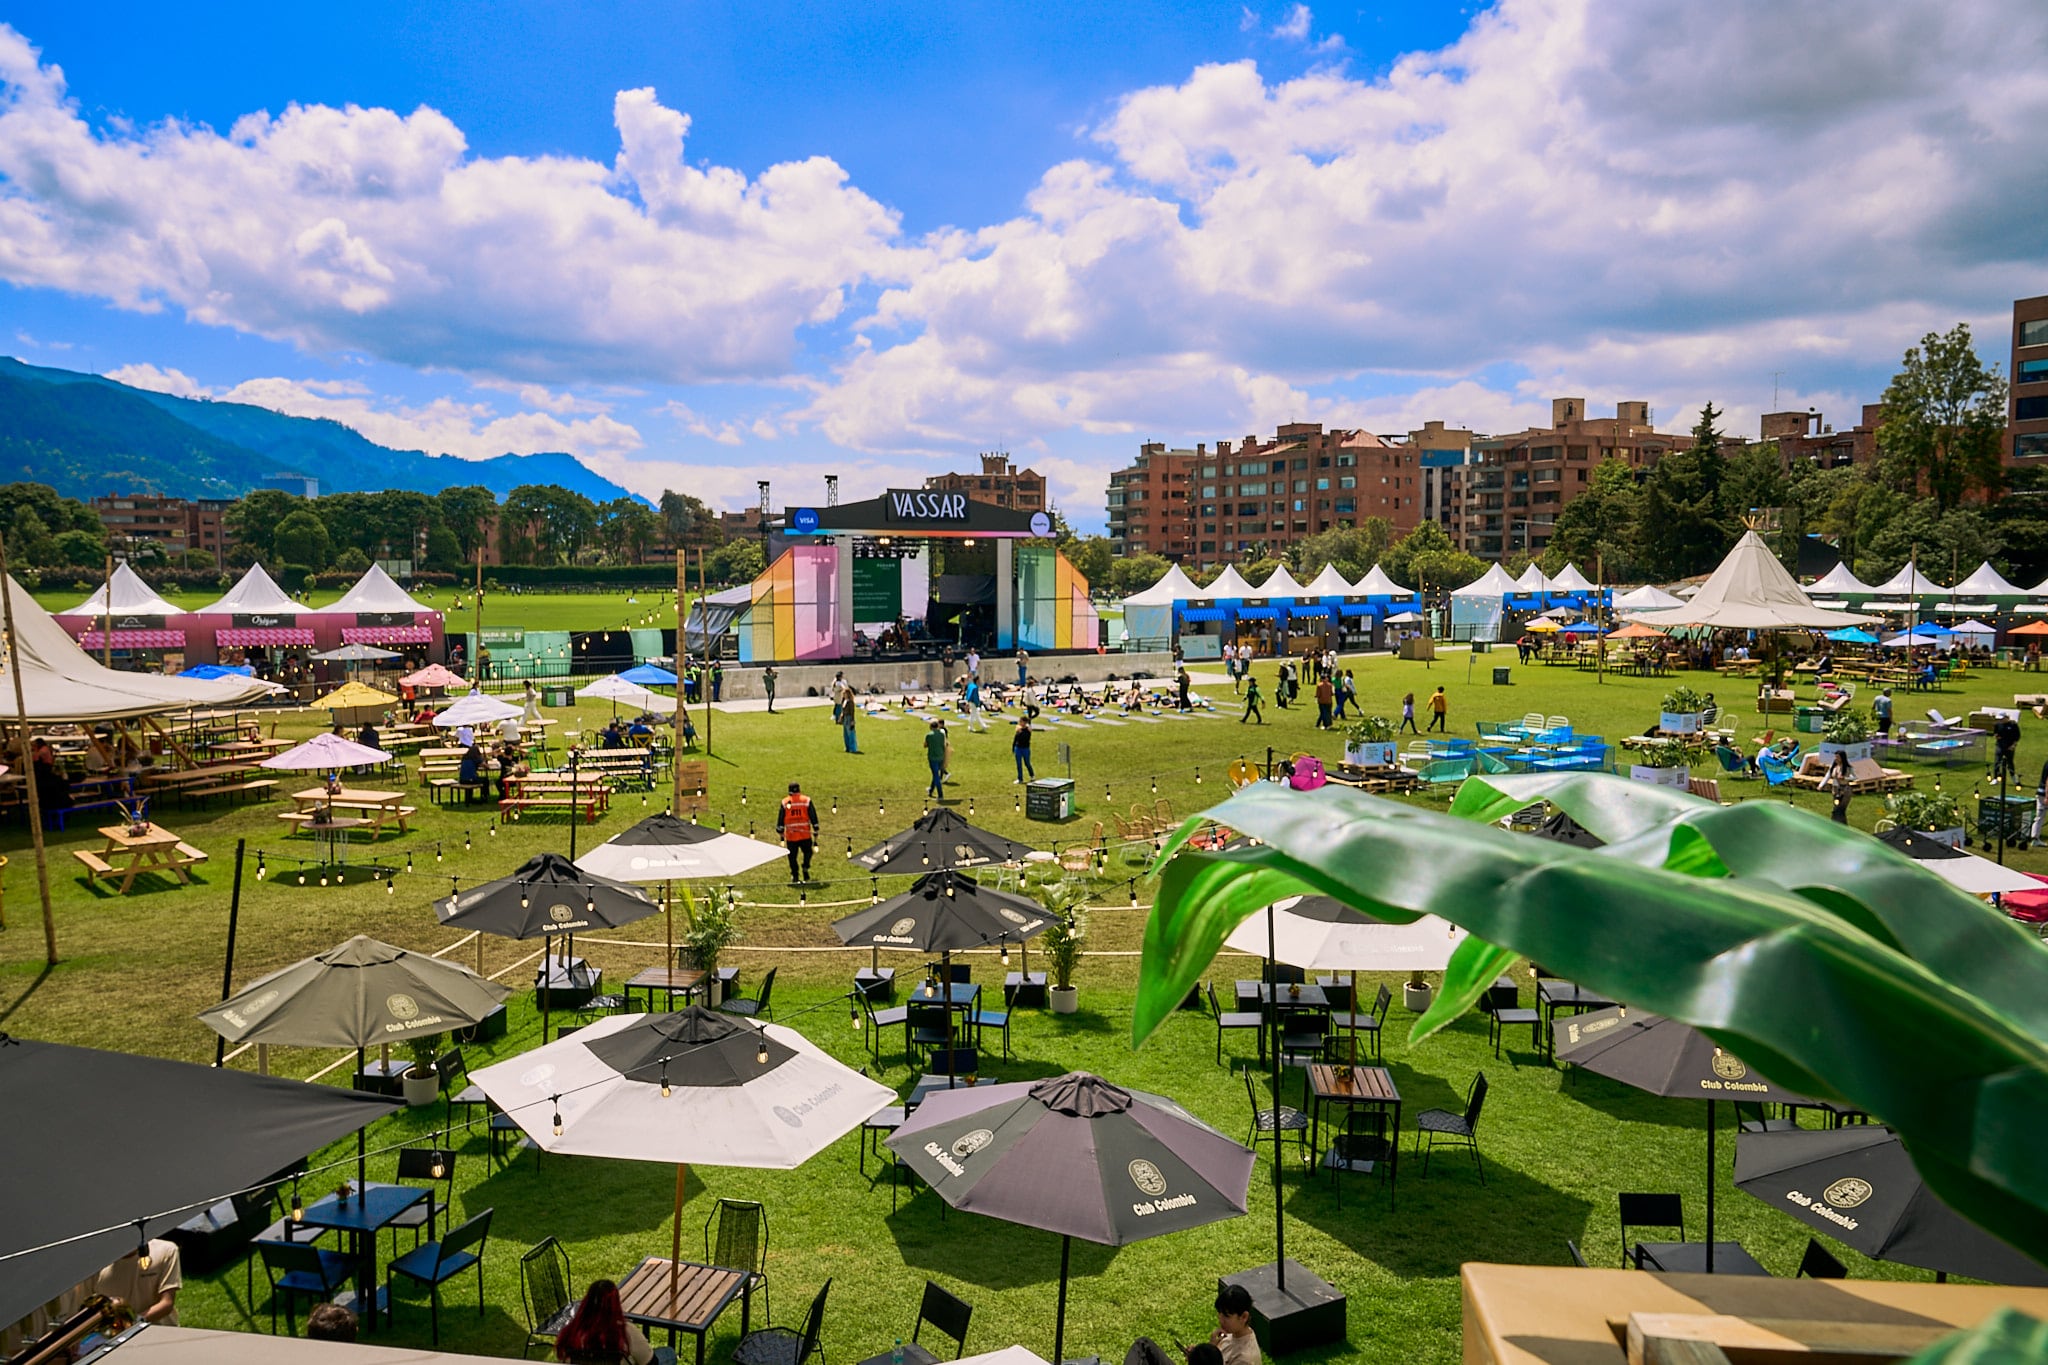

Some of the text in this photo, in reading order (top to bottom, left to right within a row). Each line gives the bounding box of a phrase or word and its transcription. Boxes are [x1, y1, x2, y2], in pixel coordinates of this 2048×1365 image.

[892, 492, 966, 519] VASSAR
[385, 1015, 442, 1033] Club Colombia
[1700, 1080, 1768, 1093] Club Colombia
[792, 1102, 813, 1116] Club
[924, 1141, 943, 1157] Club
[1133, 1193, 1198, 1217] Club Colombia
[1786, 1190, 1859, 1231] Club Colombia
